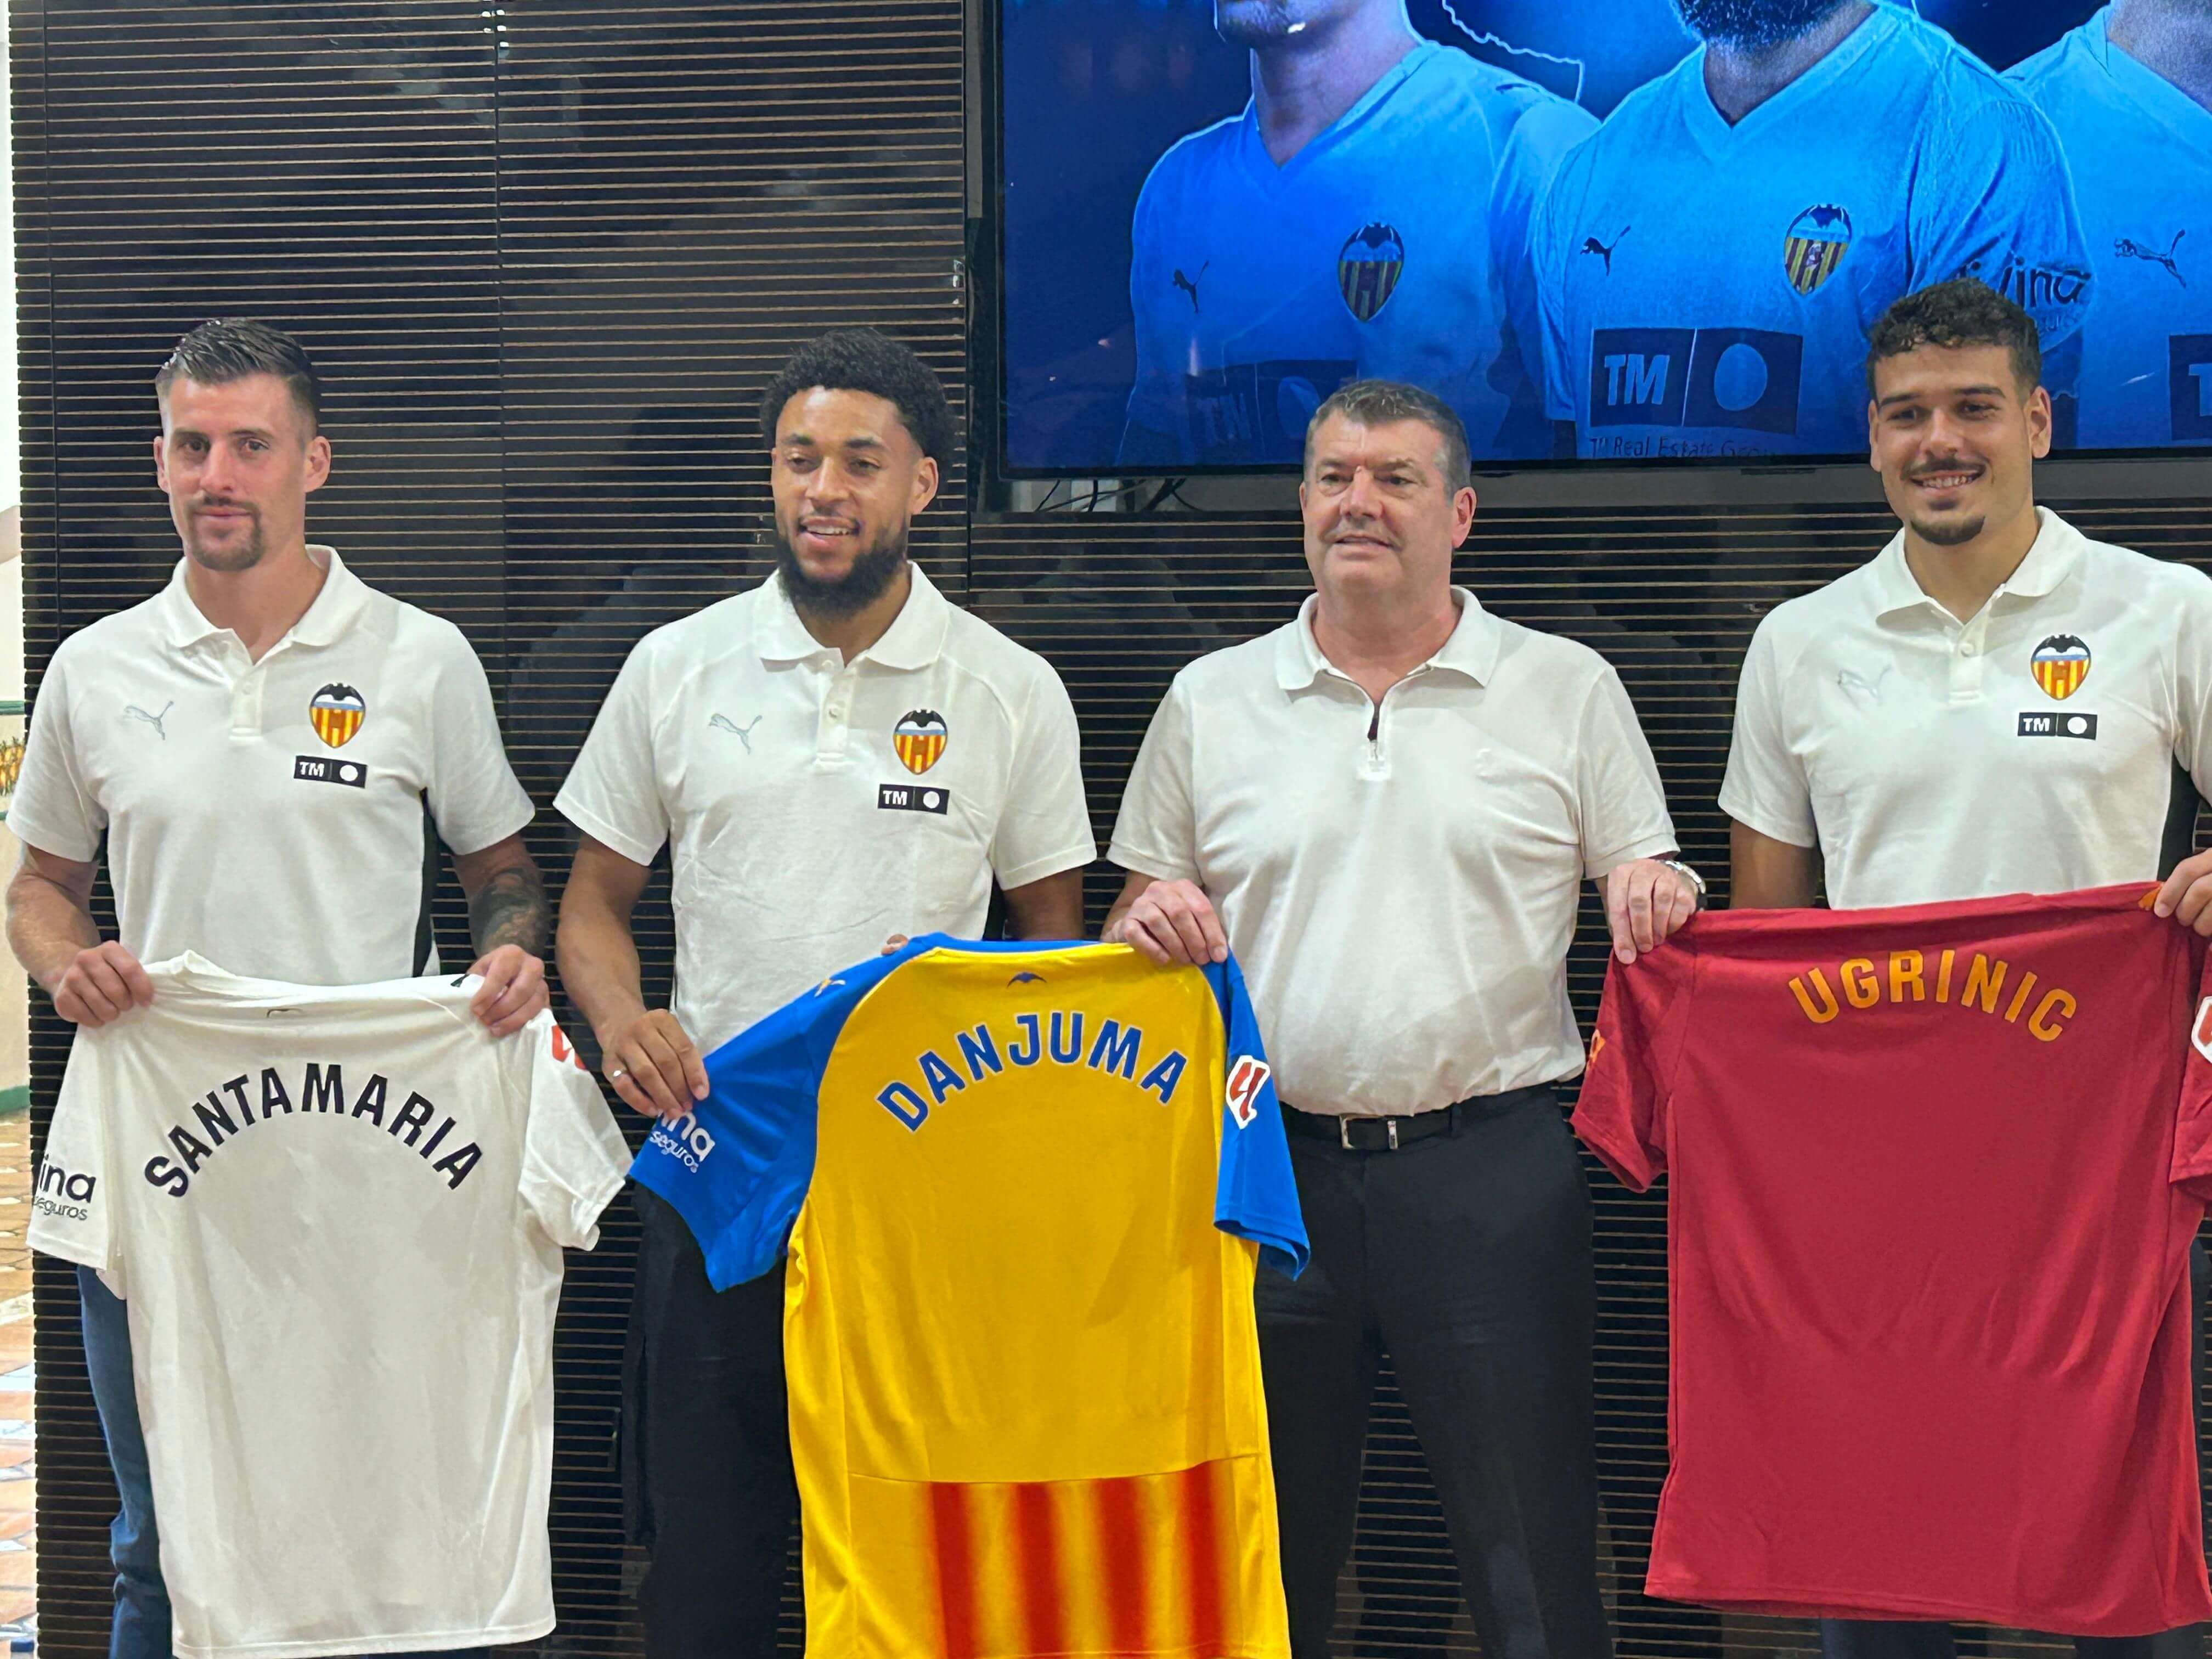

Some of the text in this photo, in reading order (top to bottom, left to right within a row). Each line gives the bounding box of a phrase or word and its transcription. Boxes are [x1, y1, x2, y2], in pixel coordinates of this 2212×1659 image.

[1604, 354, 1670, 405] TM
[1613, 437, 1650, 457] Real
[2023, 718, 2050, 732] TM
[299, 761, 325, 777] TM
[883, 791, 908, 805] TM
[1788, 950, 2076, 1041] UGRINIC
[876, 1012, 1187, 1132] DANJUMA
[144, 1063, 482, 1197] SANTAMARIA
